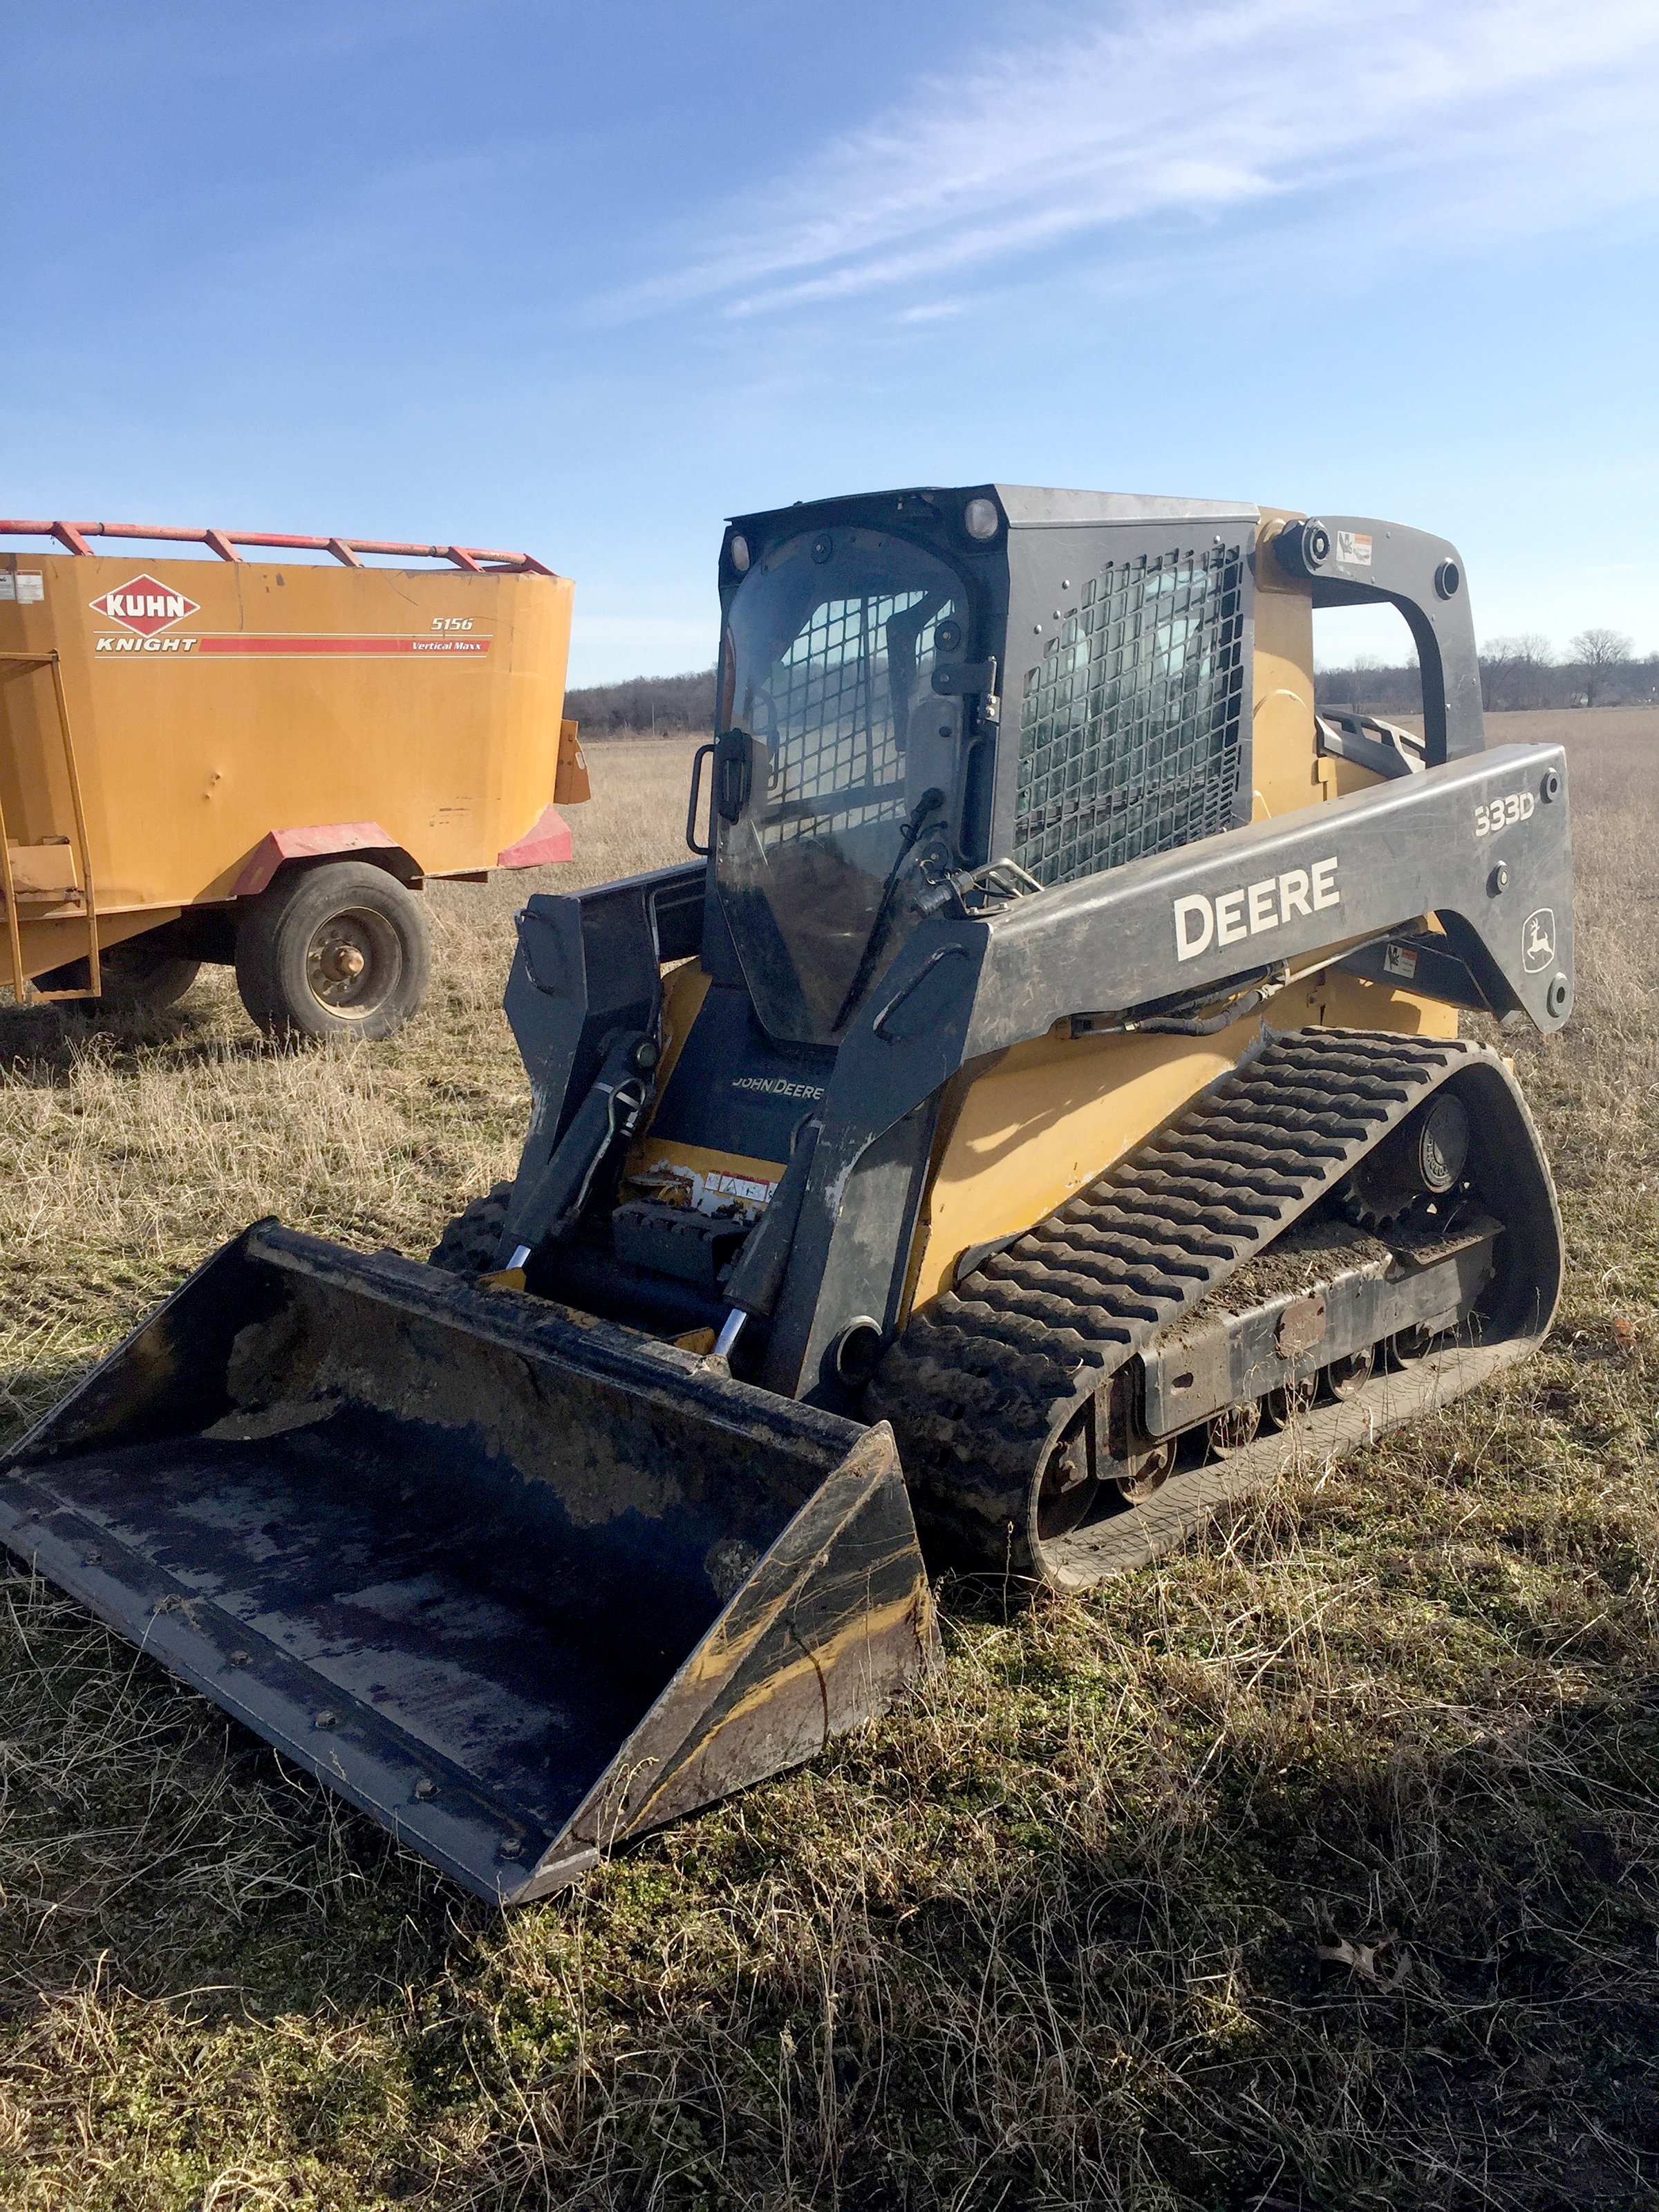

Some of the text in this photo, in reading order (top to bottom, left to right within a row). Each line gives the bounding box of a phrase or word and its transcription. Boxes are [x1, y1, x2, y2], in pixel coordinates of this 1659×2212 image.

[106, 594, 185, 617] KUHN
[430, 617, 475, 630] 5156
[95, 638, 197, 651] KNIGHT
[413, 641, 482, 650] Vertical Maxx
[1474, 791, 1535, 837] 333D
[1174, 856, 1340, 962] DEERE
[772, 1079, 825, 1100] DEERE
